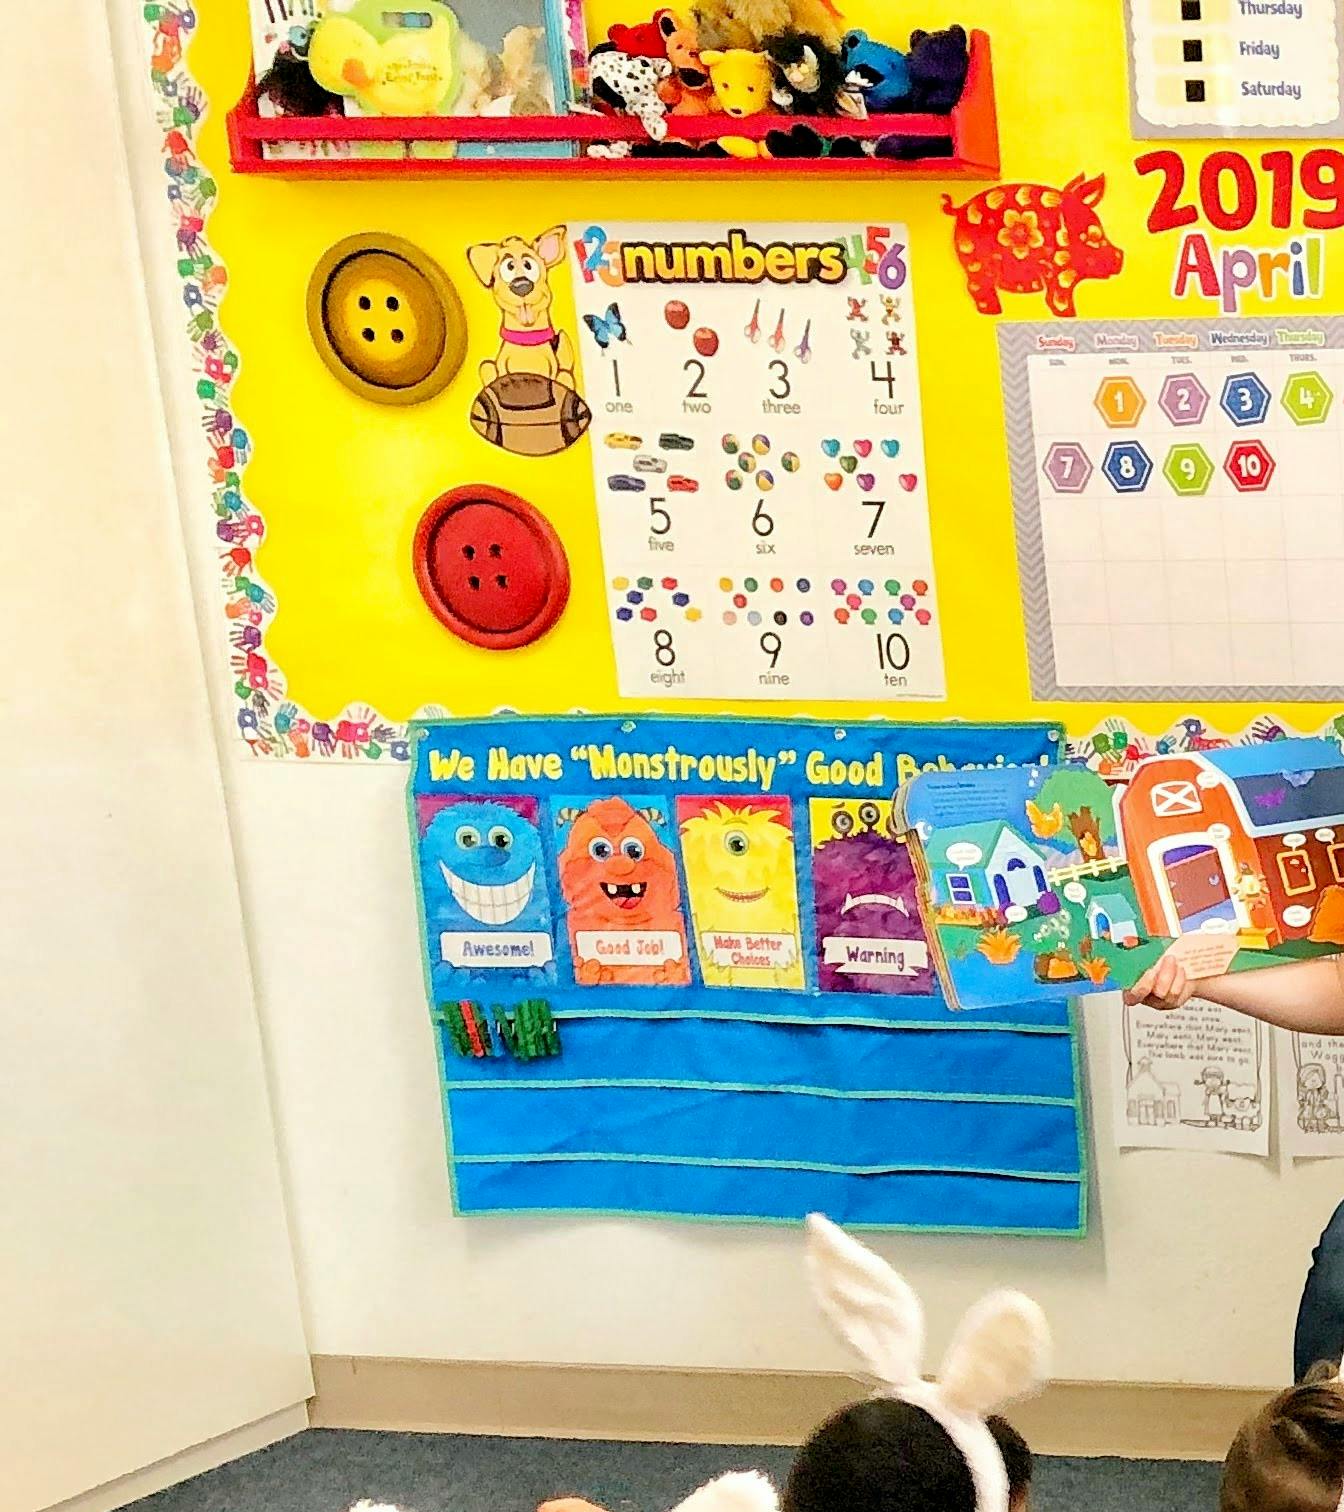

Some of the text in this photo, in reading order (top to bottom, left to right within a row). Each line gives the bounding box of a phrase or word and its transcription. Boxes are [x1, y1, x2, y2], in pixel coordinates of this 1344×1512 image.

[1238, 0, 1302, 19] Thursday
[1239, 41, 1280, 59] Friday
[1241, 81, 1302, 100] Saturday
[620, 228, 848, 284] numbers
[1175, 233, 1321, 311] April
[1038, 336, 1074, 349] Sunday
[1099, 335, 1137, 349] Monday
[1156, 333, 1196, 347] Tuesday
[1211, 332, 1267, 345] Wednesday
[1278, 330, 1323, 344] Thursday
[612, 359, 896, 399] 1 2 3 4
[605, 399, 904, 415] one two three four
[1113, 393, 1124, 412] 1
[1176, 390, 1191, 411] 2
[1239, 388, 1253, 410] 3
[1299, 387, 1315, 409] 4
[1060, 455, 1260, 480] 7 8 9 10
[650, 498, 885, 538] 5 6 7
[648, 537, 894, 557] five six seven
[653, 630, 910, 670] 8 9 10
[650, 669, 907, 687] eight nine ten
[429, 749, 474, 781] We
[488, 747, 562, 781] Have
[806, 750, 883, 787] Good
[462, 939, 535, 958] Awesome!
[596, 939, 664, 956] Good Job!
[713, 935, 782, 953] Make Better
[730, 952, 771, 967] Choices
[846, 946, 905, 972] Warning
[1301, 1039, 1322, 1049] and
